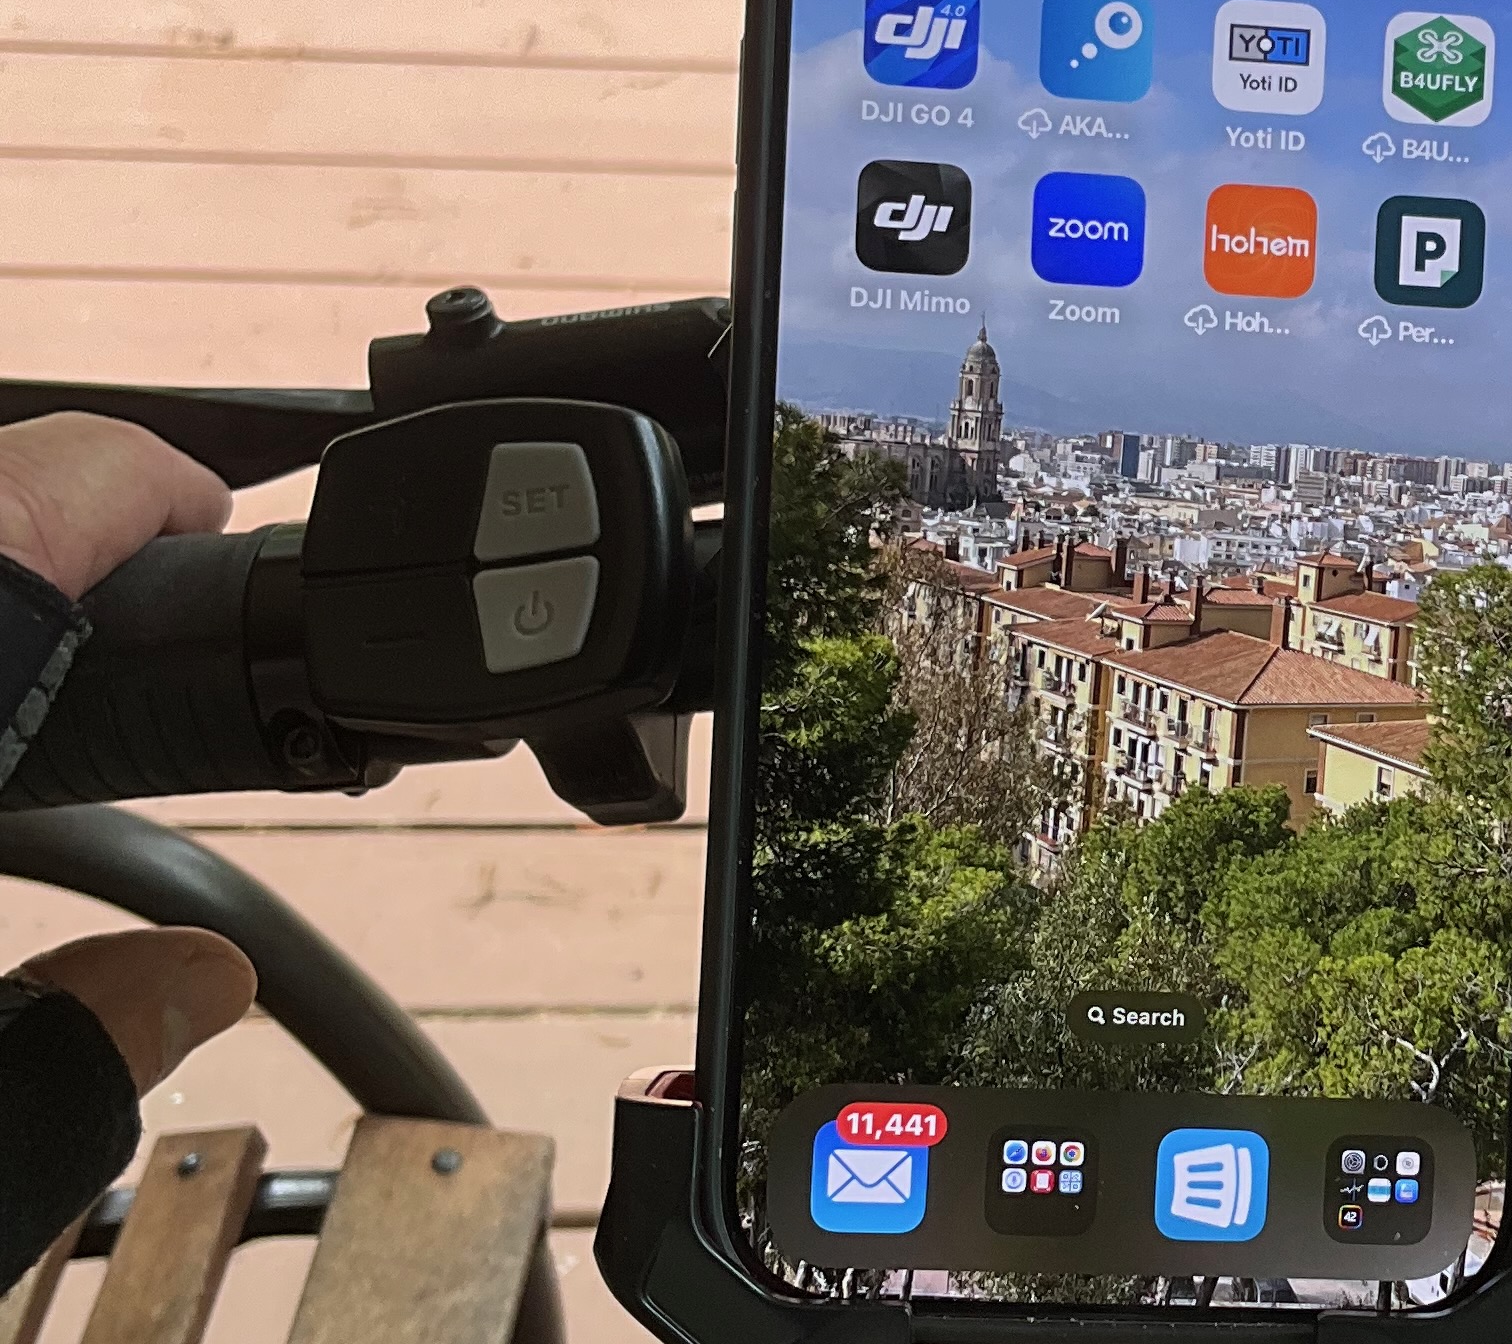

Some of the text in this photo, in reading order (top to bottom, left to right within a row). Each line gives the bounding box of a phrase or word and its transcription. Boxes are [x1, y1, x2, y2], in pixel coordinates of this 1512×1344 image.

[940, 5, 966, 17] 4.0
[1240, 74, 1298, 93] Yoti ID
[1400, 71, 1479, 92] B4UFLY
[861, 100, 976, 128] DJI GO 4
[1226, 126, 1306, 152] Yoti ID
[1048, 217, 1129, 242] zoom
[1211, 224, 1309, 258] hohem
[1414, 230, 1447, 273] P
[850, 286, 972, 315] DJI Mimo
[1048, 299, 1121, 324] Zoom
[501, 483, 569, 517] SET
[1112, 1006, 1186, 1027] Search
[846, 1113, 938, 1138] 11,441
[1343, 1210, 1358, 1223] 42
